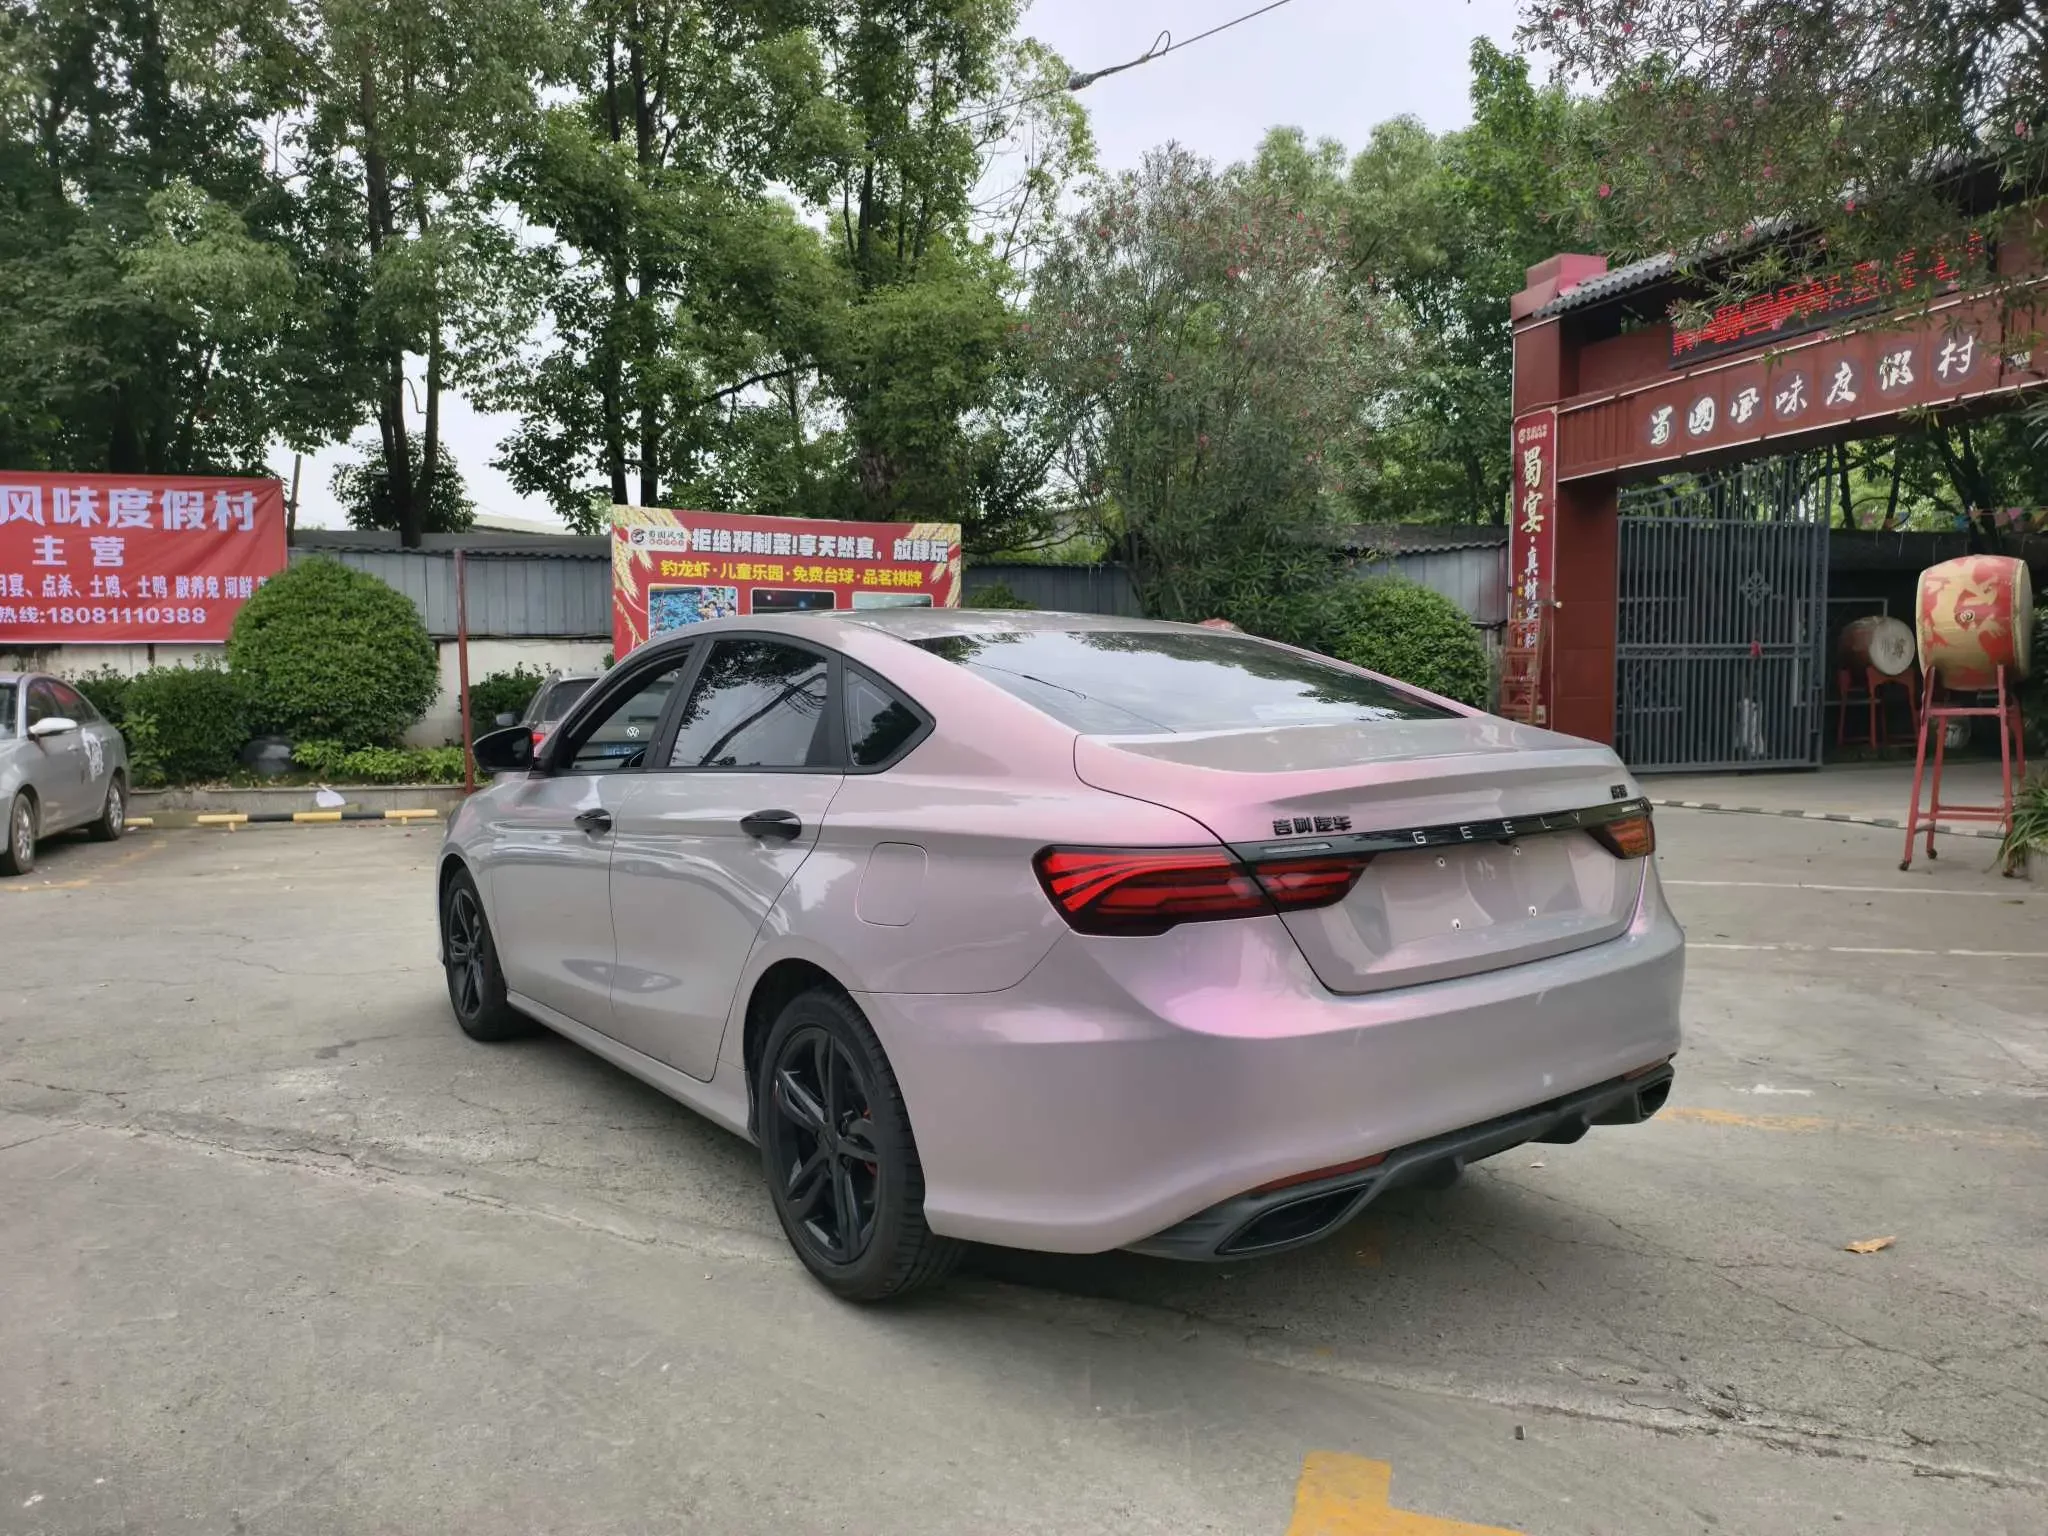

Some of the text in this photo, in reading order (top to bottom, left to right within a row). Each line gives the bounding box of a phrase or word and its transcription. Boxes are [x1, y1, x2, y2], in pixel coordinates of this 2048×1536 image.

[0, 484, 258, 532] 风味度假村
[32, 535, 125, 567] 主营
[1272, 815, 1353, 837] 吉利汽车
[1412, 811, 1581, 844] GEELY
